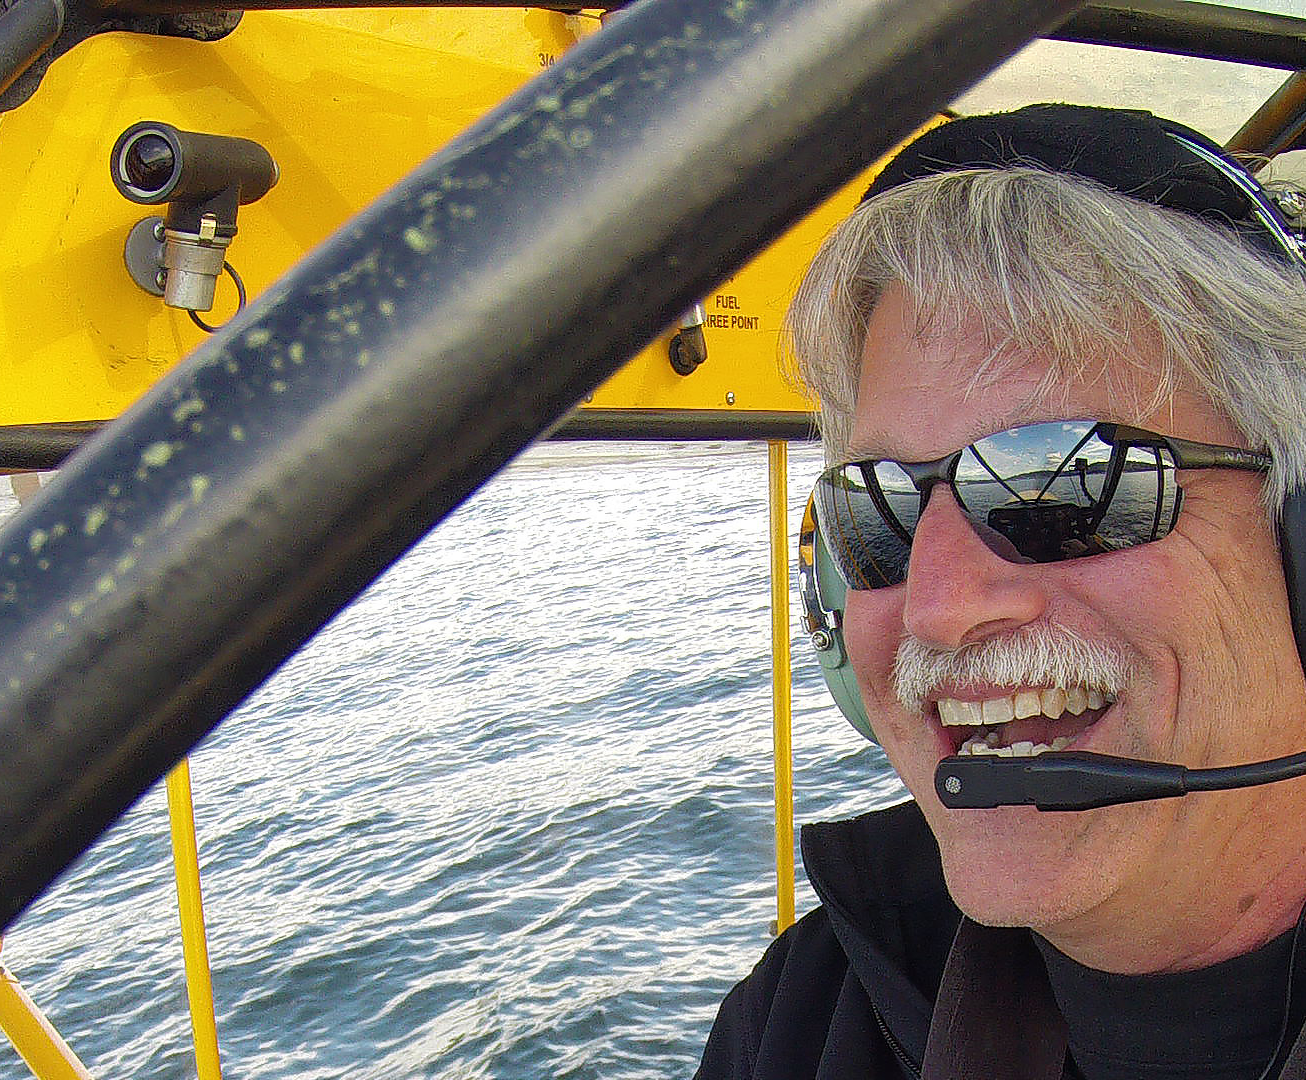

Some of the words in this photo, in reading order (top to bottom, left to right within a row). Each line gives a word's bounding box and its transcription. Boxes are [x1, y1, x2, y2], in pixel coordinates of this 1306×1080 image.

[716, 295, 740, 310] FUEL
[703, 314, 729, 328] HREE
[731, 315, 759, 330] POINT
